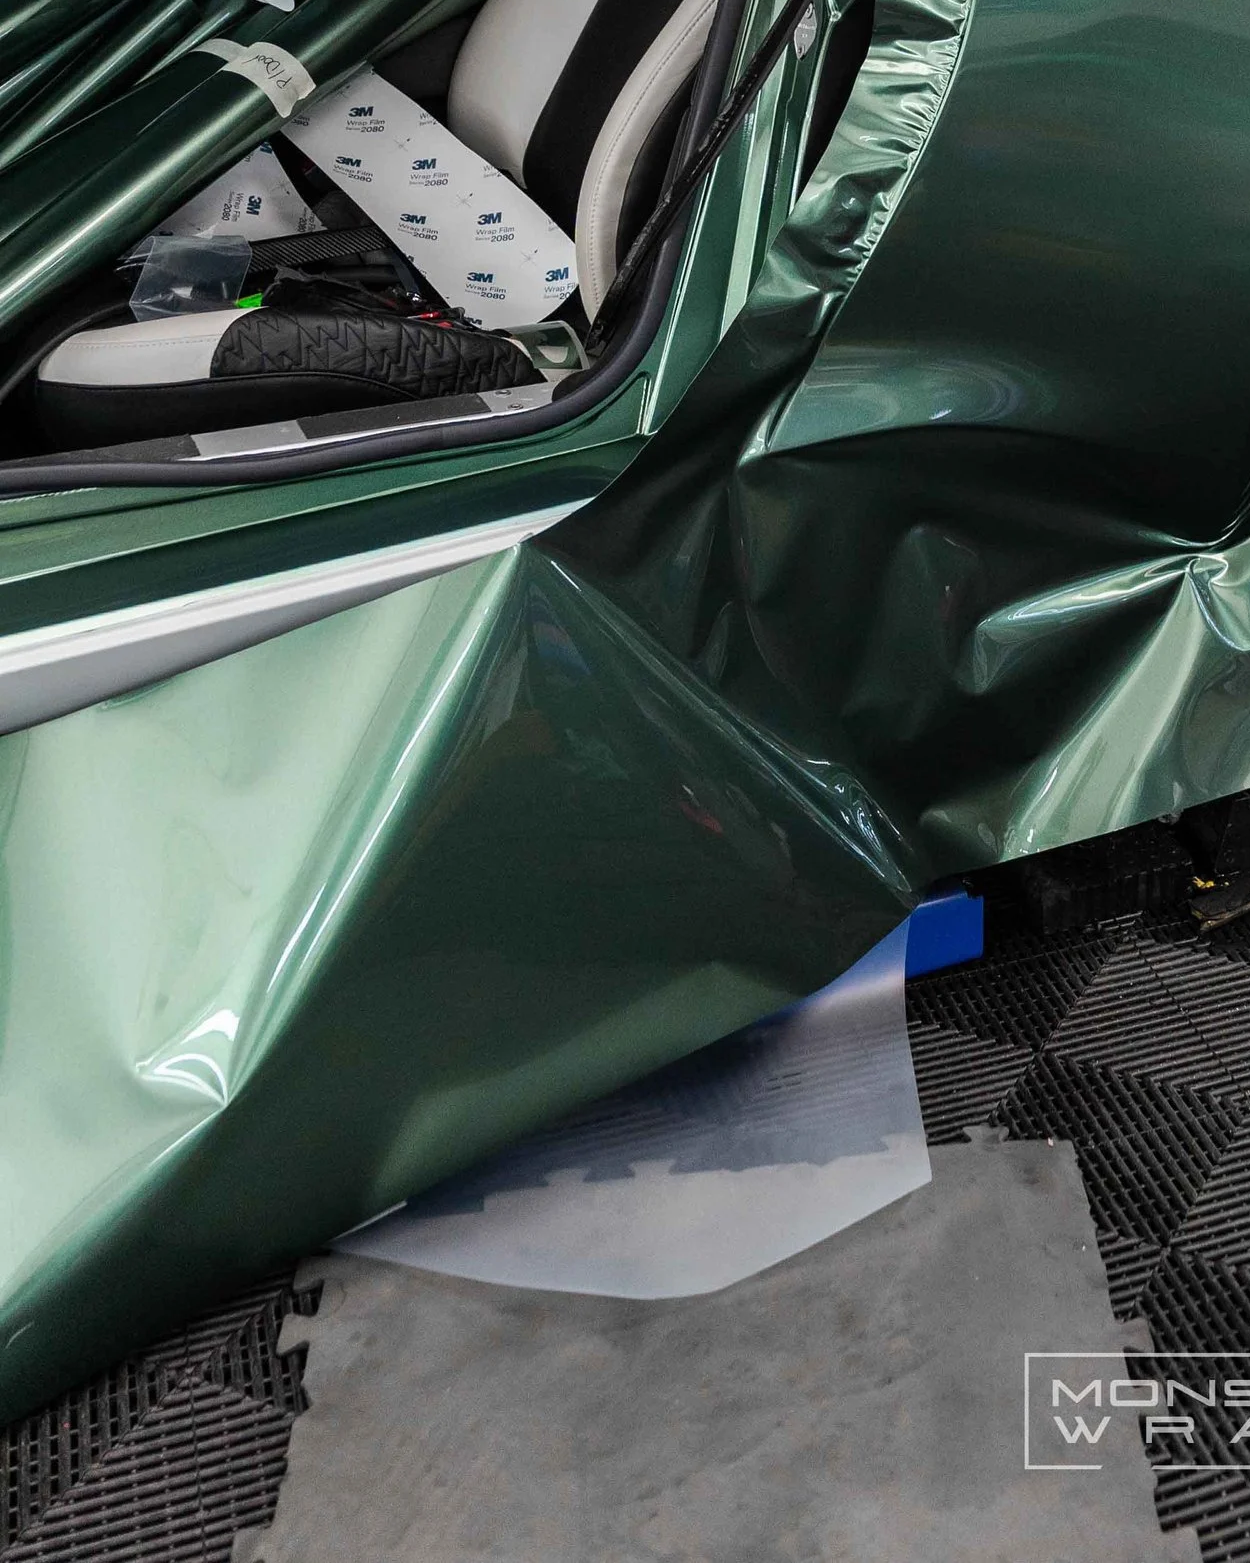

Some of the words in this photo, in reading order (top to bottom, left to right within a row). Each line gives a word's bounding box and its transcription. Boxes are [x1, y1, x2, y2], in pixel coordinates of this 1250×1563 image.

[348, 106, 374, 117] 3M
[335, 156, 362, 168] 3M
[412, 158, 437, 170] 3M
[333, 164, 355, 174] Wrap
[348, 173, 372, 183] 2080
[246, 195, 262, 216] 3M
[221, 203, 232, 221] 2080
[400, 213, 427, 225] 3M
[477, 212, 502, 225] 3M
[398, 223, 421, 232] Wrap
[413, 232, 438, 241] 2080
[490, 233, 515, 243] 2080
[467, 272, 494, 284] 3M
[545, 267, 569, 282] 3M
[465, 283, 487, 292] Wrap
[489, 286, 507, 294] Film
[544, 285, 565, 294] Wrap
[480, 291, 506, 300] 2080
